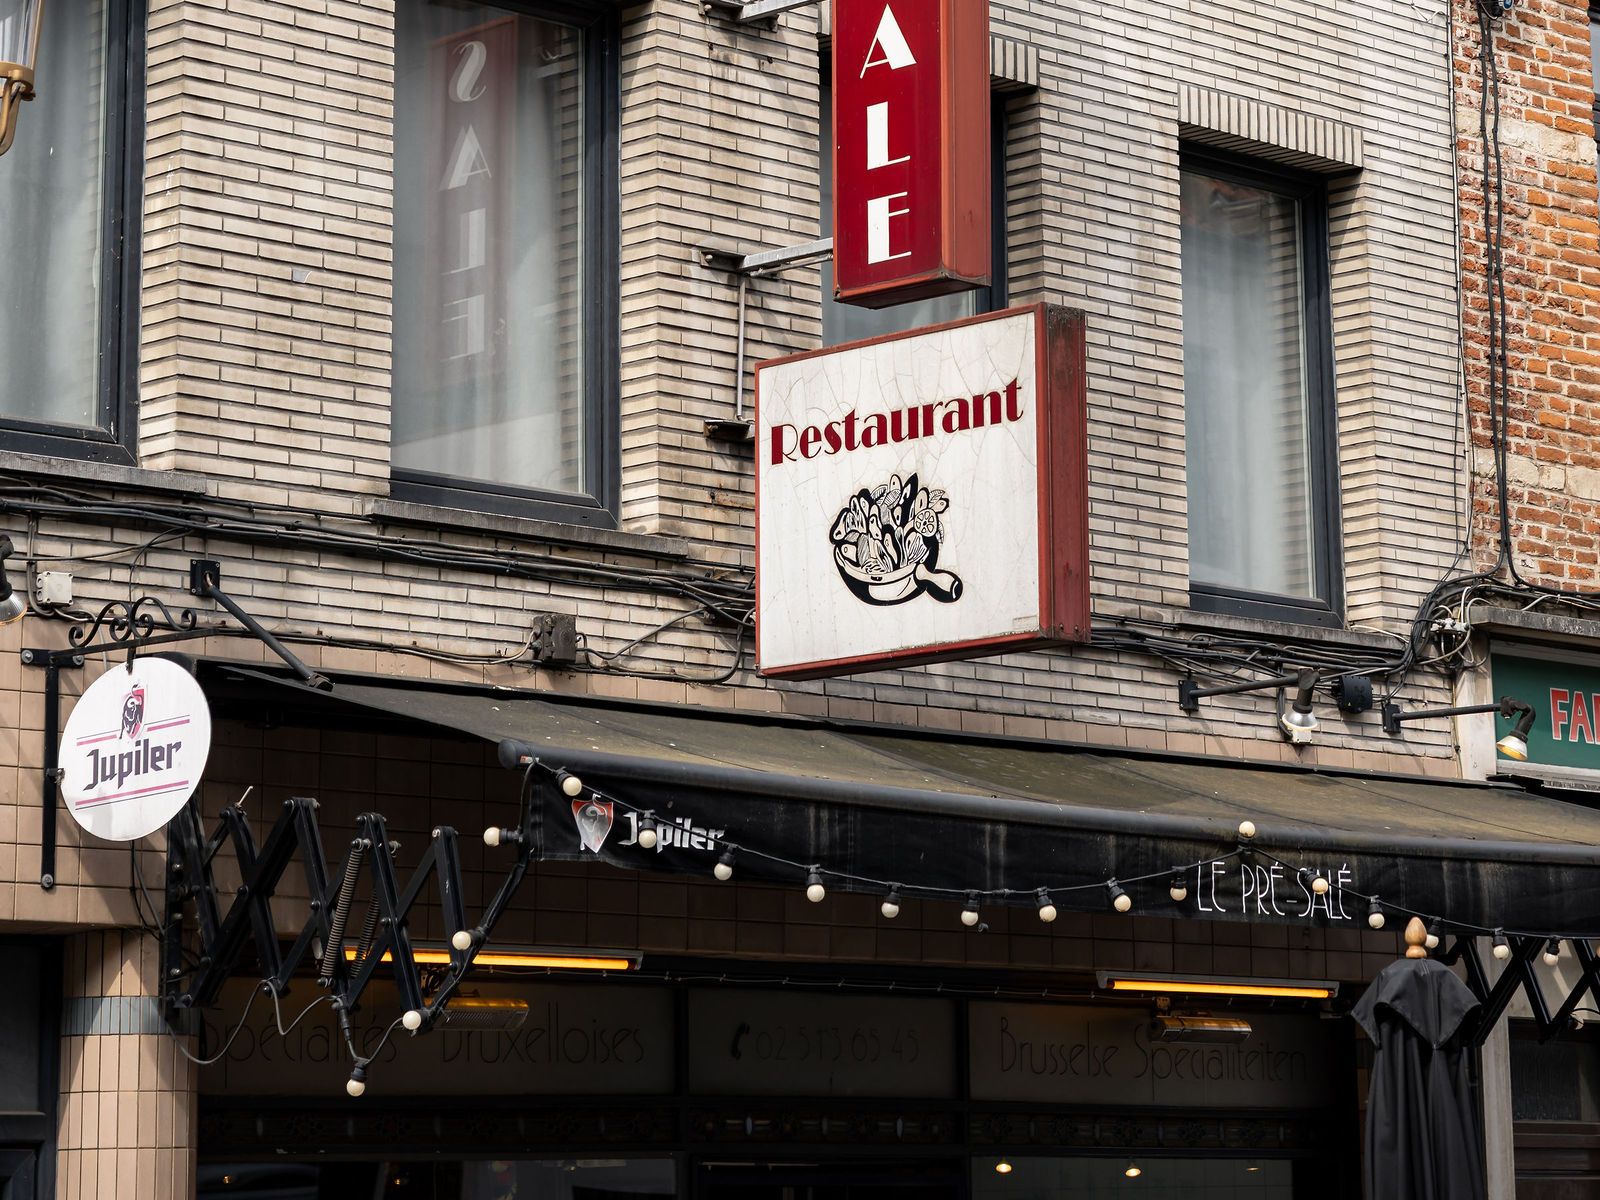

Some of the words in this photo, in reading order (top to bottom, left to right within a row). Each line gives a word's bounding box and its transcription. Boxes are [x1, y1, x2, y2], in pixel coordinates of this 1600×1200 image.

[771, 377, 1024, 465] Restaurant
[83, 738, 182, 792] Jupiler
[618, 811, 725, 853] Jpiler
[1197, 860, 1226, 913] LE
[1000, 1015, 1119, 1076] Brusselse
[1133, 1023, 1307, 1102] Specialiteiten
